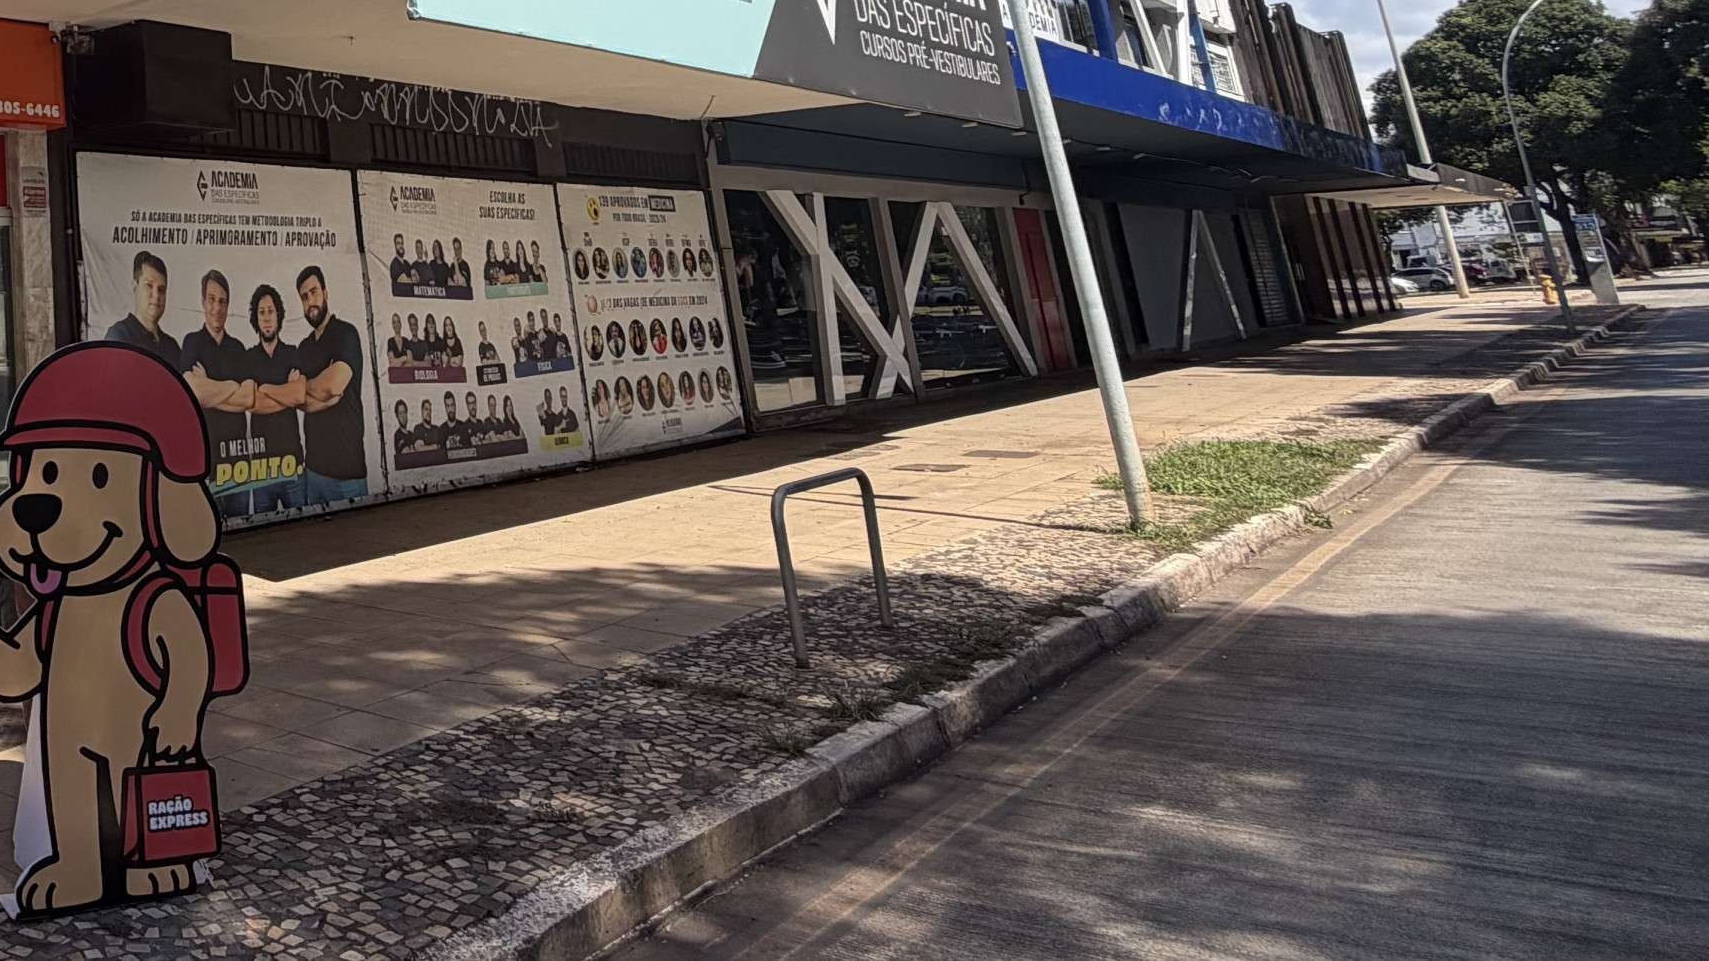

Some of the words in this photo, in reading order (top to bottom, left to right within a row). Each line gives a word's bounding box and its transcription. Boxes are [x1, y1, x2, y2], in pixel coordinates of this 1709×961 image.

[859, 30, 908, 64] CURSOS
[906, 41, 1002, 86] PRÉ-VESTIBULARES
[211, 170, 259, 190] ACADEMIA
[489, 190, 516, 204] ESCOLHA
[148, 211, 182, 224] ACADEMIA
[112, 226, 188, 245] ACOLHIMENTO
[195, 229, 278, 247] APRIMORAMENTO
[284, 229, 337, 250] APROVAÇÃO
[220, 441, 227, 458] O
[216, 454, 304, 487] PONTO.
[148, 796, 193, 815] RAÇÃO
[149, 811, 209, 831] EXPRESS
